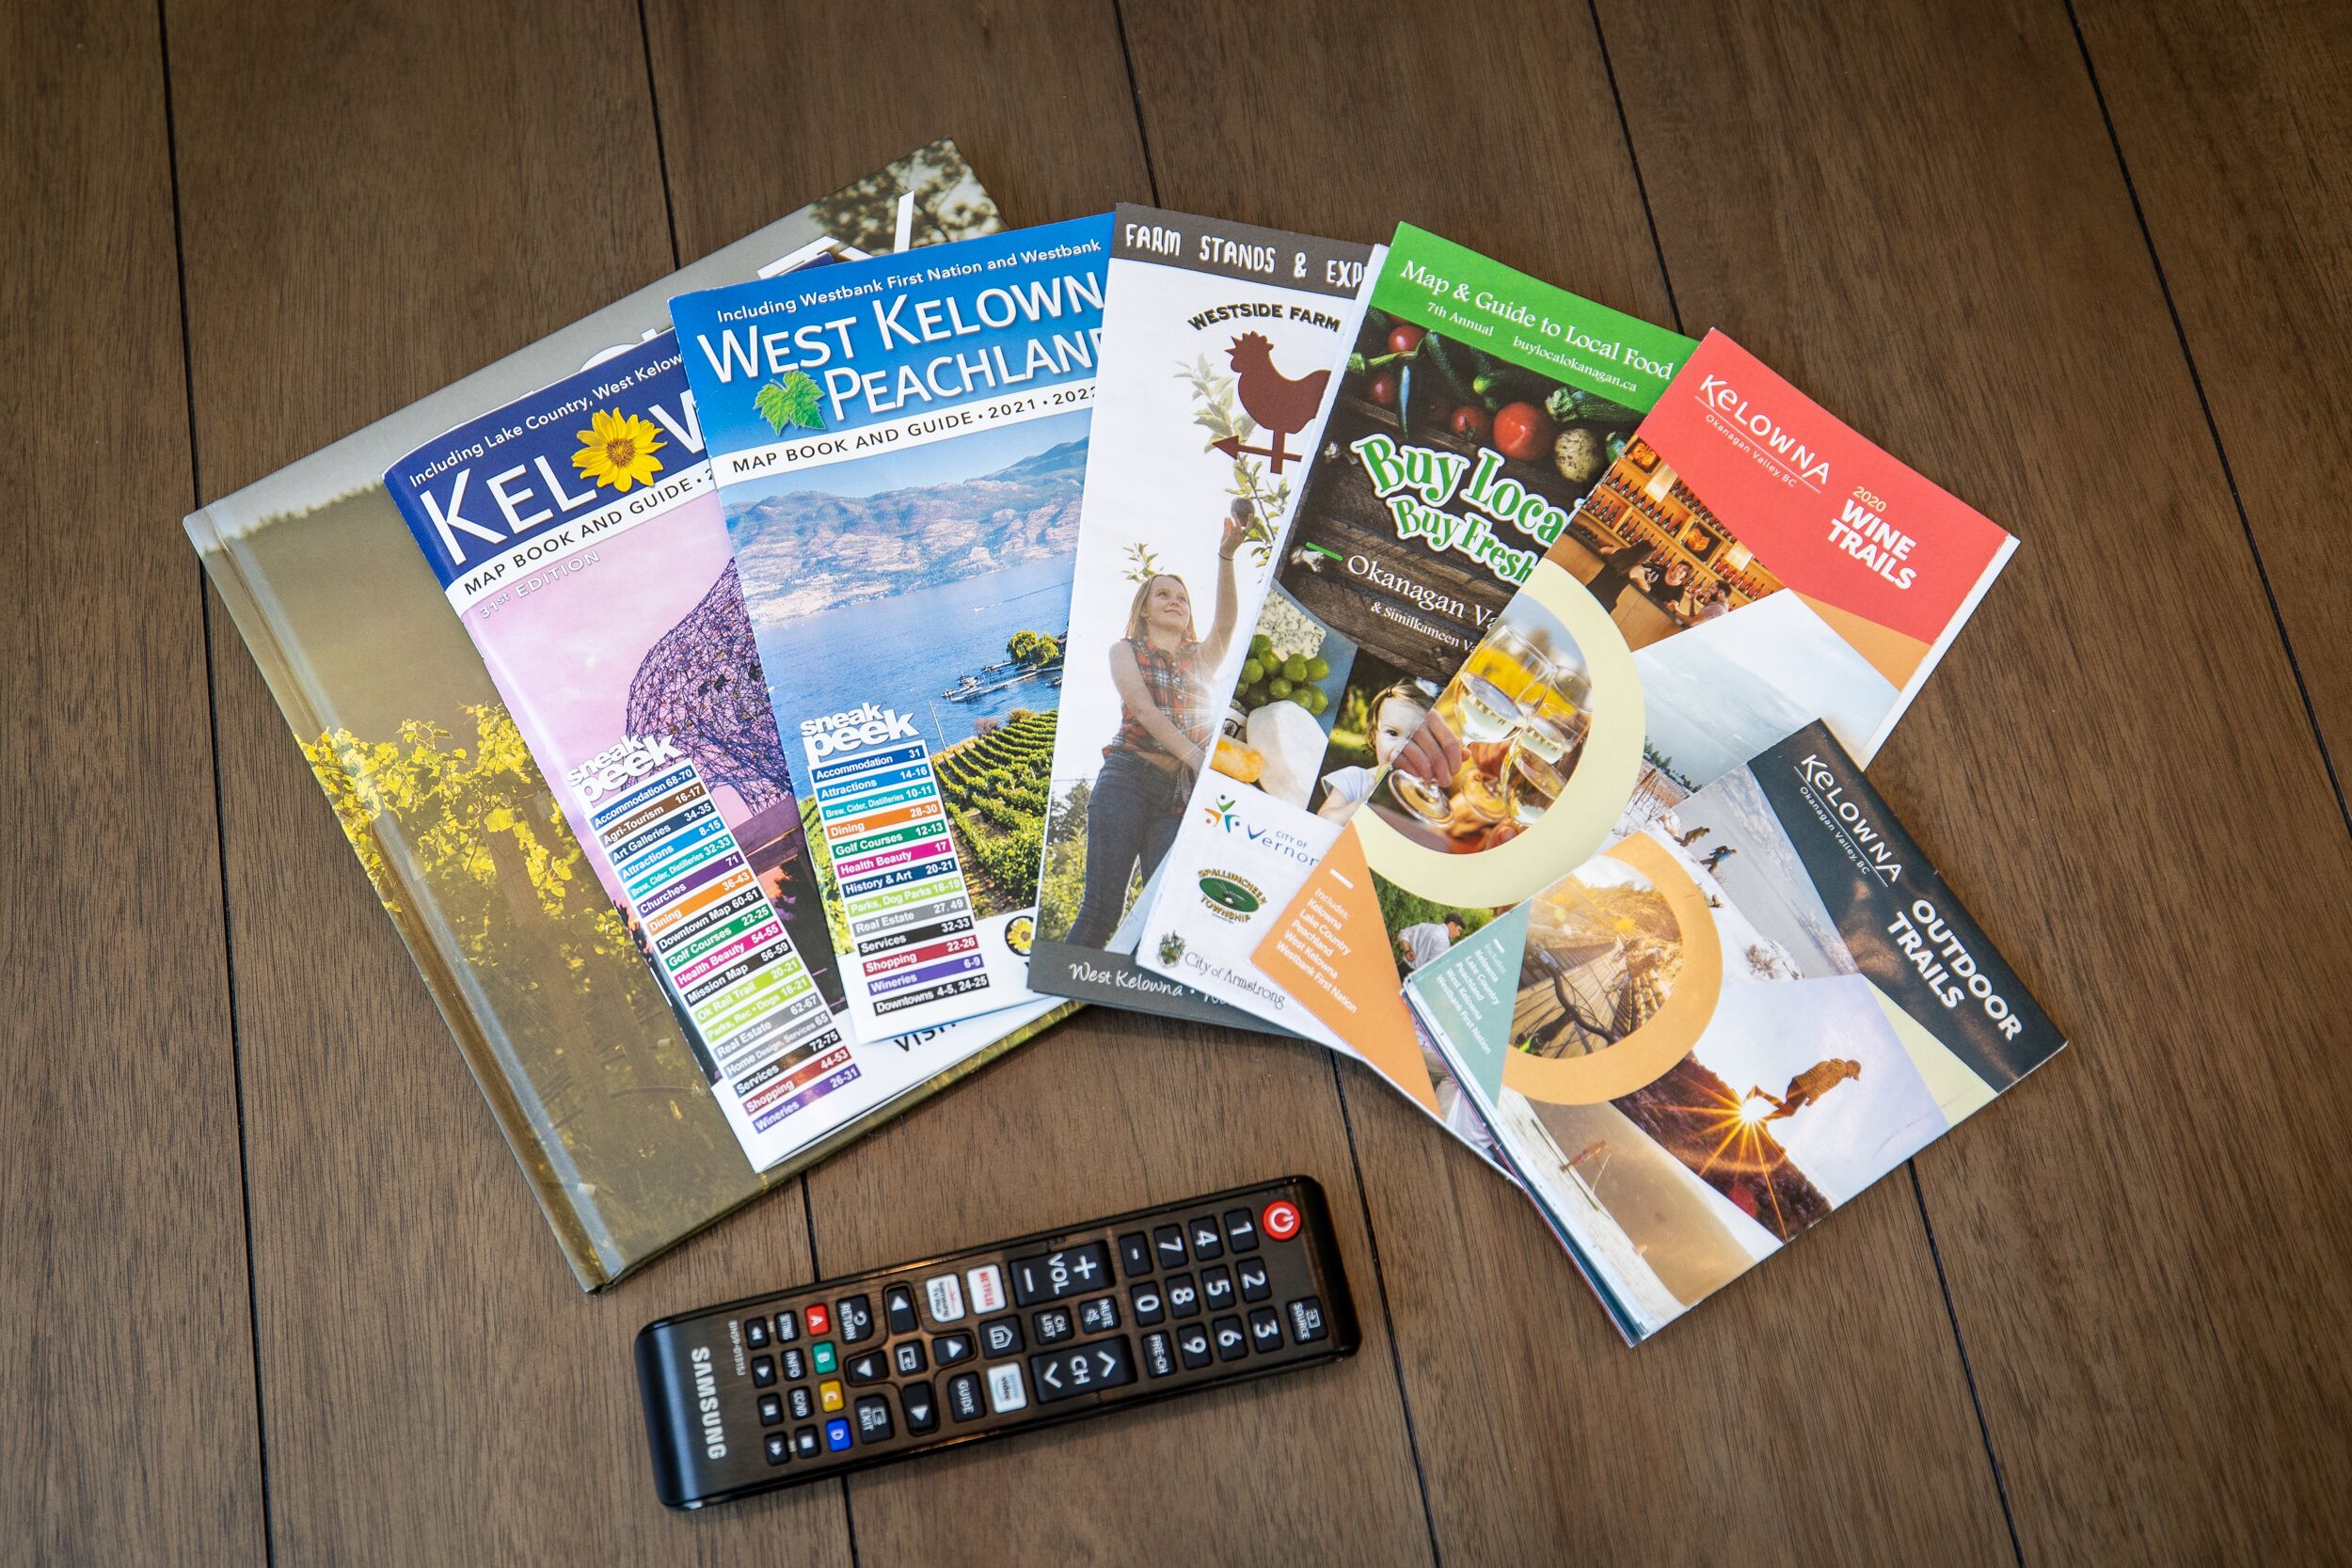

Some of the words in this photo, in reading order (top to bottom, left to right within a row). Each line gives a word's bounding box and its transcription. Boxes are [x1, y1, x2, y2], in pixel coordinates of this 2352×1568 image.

[1125, 223, 1181, 257] FARM
[1200, 235, 1276, 273] STANDS
[1294, 252, 1307, 277] &
[1327, 260, 1367, 288] EXP
[717, 298, 798, 324] Including
[799, 278, 884, 307] Westbank
[887, 272, 924, 290] First
[928, 261, 982, 282] Nation
[987, 254, 1018, 271] and
[1021, 239, 1102, 264] Westbank
[1188, 303, 1282, 330] WESTSIDE
[1290, 306, 1342, 332] FARM
[1400, 260, 1450, 297] Map
[1453, 283, 1470, 302] &
[1475, 291, 1536, 328] Guide
[1541, 318, 1562, 337] to
[1565, 325, 1619, 360] Local
[1622, 347, 1675, 380] Food
[1426, 302, 1447, 318] 7th
[1450, 310, 1495, 337] Annual
[1512, 336, 1638, 392] buylocalokanagan.ca
[409, 443, 484, 487] Including
[485, 425, 523, 449] Lake
[526, 396, 594, 430] Country,
[593, 375, 634, 401] West
[732, 452, 777, 474] MAP
[787, 439, 848, 463] BOOK
[856, 428, 898, 449] AND
[908, 411, 974, 437] GUIDE
[988, 399, 1037, 420] 2021
[1706, 414, 1751, 452] Okanagan
[1782, 473, 1798, 487] BC
[1352, 436, 1470, 506] Buy
[1461, 449, 1569, 545] Loca
[1851, 485, 1887, 513] 2020
[465, 563, 506, 595] MAP
[512, 531, 574, 568] BOOK
[580, 511, 623, 539] AND
[629, 481, 693, 515] GUIDE
[1389, 498, 1464, 548] Buy
[1840, 499, 1916, 561] WINE
[1826, 518, 1917, 590] TRAILS
[480, 591, 511, 619] 31st
[516, 549, 601, 599] EDITION
[1347, 555, 1466, 619] Okanagan
[1371, 601, 1381, 613] &
[1383, 606, 1460, 646] Similkameen
[800, 702, 884, 736] sneak
[803, 709, 920, 768] peek
[566, 734, 645, 786] sneak
[573, 735, 684, 806] peek
[817, 755, 893, 780] Accommodation
[909, 749, 921, 759] 31
[594, 784, 666, 828] Accommodation
[665, 768, 693, 787] 68-70
[820, 779, 878, 799] Attractions
[900, 767, 928, 780] 14-16
[868, 793, 905, 808] Distilleries
[906, 785, 932, 799] 10-11
[603, 805, 664, 846] Agri-Tourism
[675, 785, 701, 804] 16-17
[612, 849, 629, 863] Art
[628, 825, 672, 851] Galleries
[684, 802, 712, 822] 34-35
[831, 821, 865, 837] Dining
[910, 804, 938, 818] 28-30
[622, 845, 675, 879] Attractions
[698, 819, 722, 836] 8-15
[835, 843, 858, 855] Golf
[860, 832, 903, 849] Courses
[915, 822, 944, 836] 12-13
[840, 860, 874, 875] Health
[876, 851, 913, 867] Beauty
[935, 842, 946, 851] 17
[640, 883, 687, 913] Churches
[725, 855, 739, 867] 71
[846, 879, 882, 895] History
[885, 875, 895, 884] &
[896, 870, 913, 881] Art
[926, 861, 953, 875] 20-21
[649, 909, 683, 932] Dining
[722, 872, 750, 892] 36-43
[659, 916, 710, 949] Downtown
[708, 904, 732, 922] Map
[731, 889, 759, 909] 60-61
[855, 921, 880, 934] Real
[882, 912, 914, 924] Estate
[950, 899, 963, 910] 49
[1308, 898, 1342, 930] Kelowna
[668, 949, 691, 967] Golf
[690, 927, 732, 954] Courses
[740, 908, 770, 927] 22-25
[860, 934, 907, 953] Services
[942, 918, 971, 933] 32-33
[1293, 919, 1334, 957] Peachland
[1299, 910, 1319, 928] Lake
[1319, 923, 1351, 955] Country
[677, 963, 710, 985] Health
[708, 942, 746, 966] Beauty
[751, 925, 779, 944] 54-55
[687, 975, 726, 1004] Mission
[724, 964, 749, 982] Map
[760, 942, 788, 962] 56-59
[866, 952, 917, 973] Shopping
[946, 937, 976, 952] 22-26
[870, 974, 917, 993] Wineries
[963, 956, 981, 969] 6-9
[1276, 941, 1316, 977] Westbank
[1315, 972, 1333, 990] First
[1330, 986, 1357, 1013] Nation
[1887, 911, 1965, 1008] TRAILS
[1912, 898, 2022, 1040] OUTDOOR
[876, 990, 934, 1013] Downtowns
[958, 974, 988, 990] 24-25
[1069, 962, 1112, 986] West
[1115, 970, 1184, 997] Kelowna
[1185, 952, 1212, 975] City
[1211, 966, 1224, 978] of
[1225, 971, 1285, 1010] Armstrong
[737, 1064, 780, 1094] Services
[809, 1032, 838, 1053] 72-75
[746, 1081, 795, 1113] Shopping
[820, 1050, 849, 1069] 44-53
[1159, 1236, 1184, 1253] 7
[1197, 1229, 1218, 1248] 4
[1230, 1221, 1253, 1236] 1
[1048, 1252, 1069, 1295] VOL
[1207, 1278, 1231, 1298] 5
[1242, 1271, 1266, 1289] 2
[1098, 1298, 1115, 1328] MUTE
[1136, 1294, 1159, 1312] 0
[1170, 1287, 1195, 1305] 8
[838, 1303, 856, 1340] RETURN
[1218, 1328, 1243, 1347] 6
[1254, 1319, 1279, 1338] 3
[1292, 1301, 1311, 1340] SOURCE
[1150, 1334, 1169, 1375] PRE-CH
[1182, 1337, 1206, 1354] 9
[1070, 1356, 1090, 1386] CH
[691, 1346, 727, 1460] SAMSUNG
[957, 1379, 975, 1415] GUIDE
